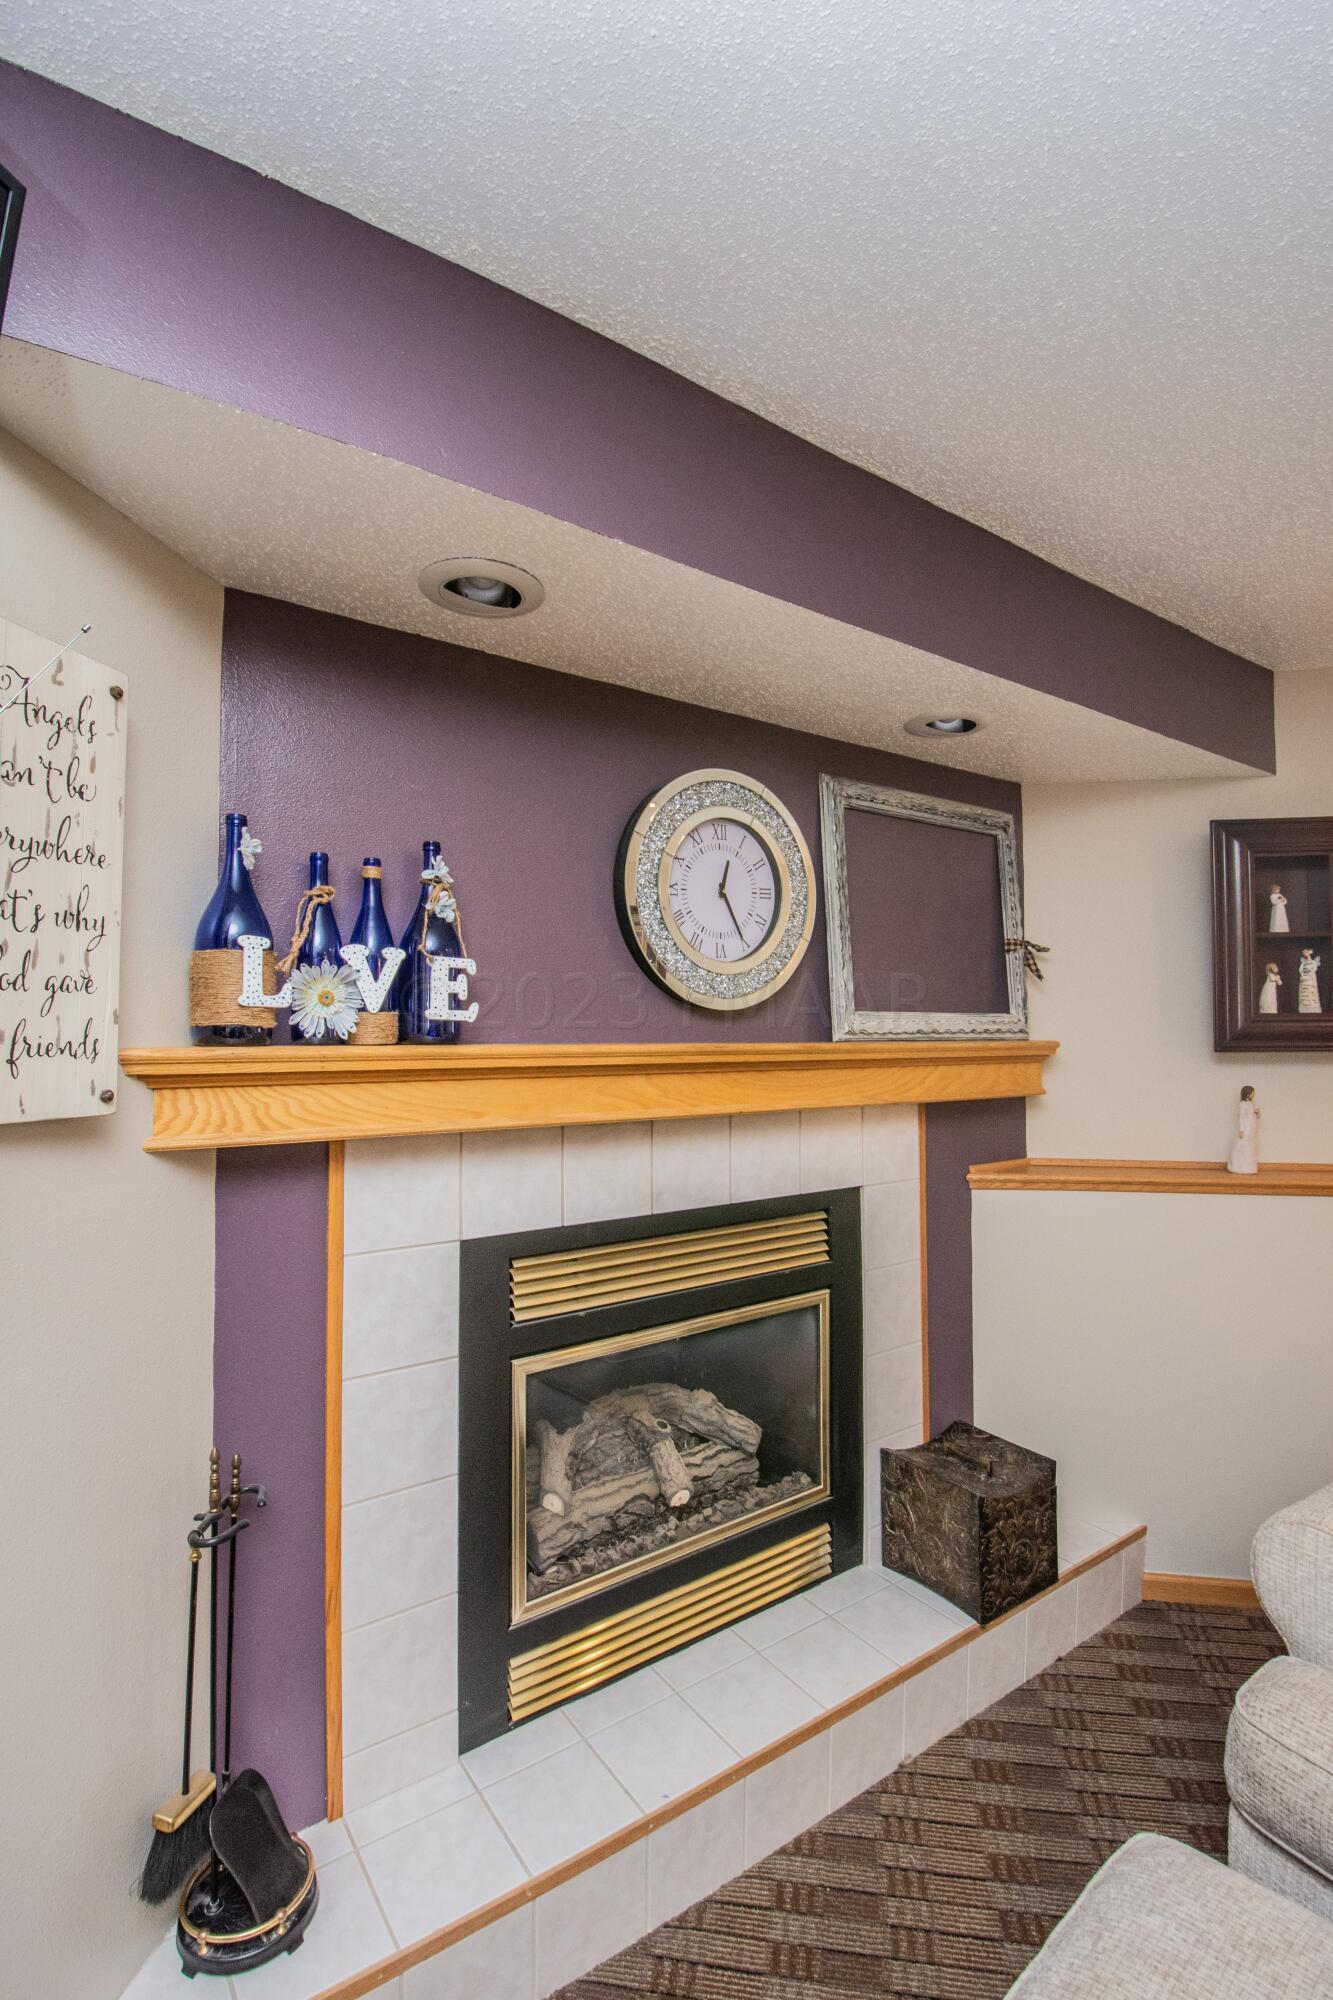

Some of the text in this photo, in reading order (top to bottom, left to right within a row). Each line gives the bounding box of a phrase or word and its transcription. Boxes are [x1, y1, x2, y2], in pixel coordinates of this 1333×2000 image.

[0, 665, 97, 750] Angels
[67, 756, 97, 802] be
[688, 828, 704, 848] XI
[711, 823, 728, 841] XII
[673, 855, 685, 867] X
[752, 857, 766, 871] II
[759, 887, 772, 900] III
[54, 884, 107, 952] why
[753, 913, 768, 931] IV
[690, 931, 704, 952] VII
[715, 942, 727, 959] VI
[0, 945, 98, 1017] od gave
[237, 935, 479, 1022] LVE
[6, 1017, 100, 1079] friends
